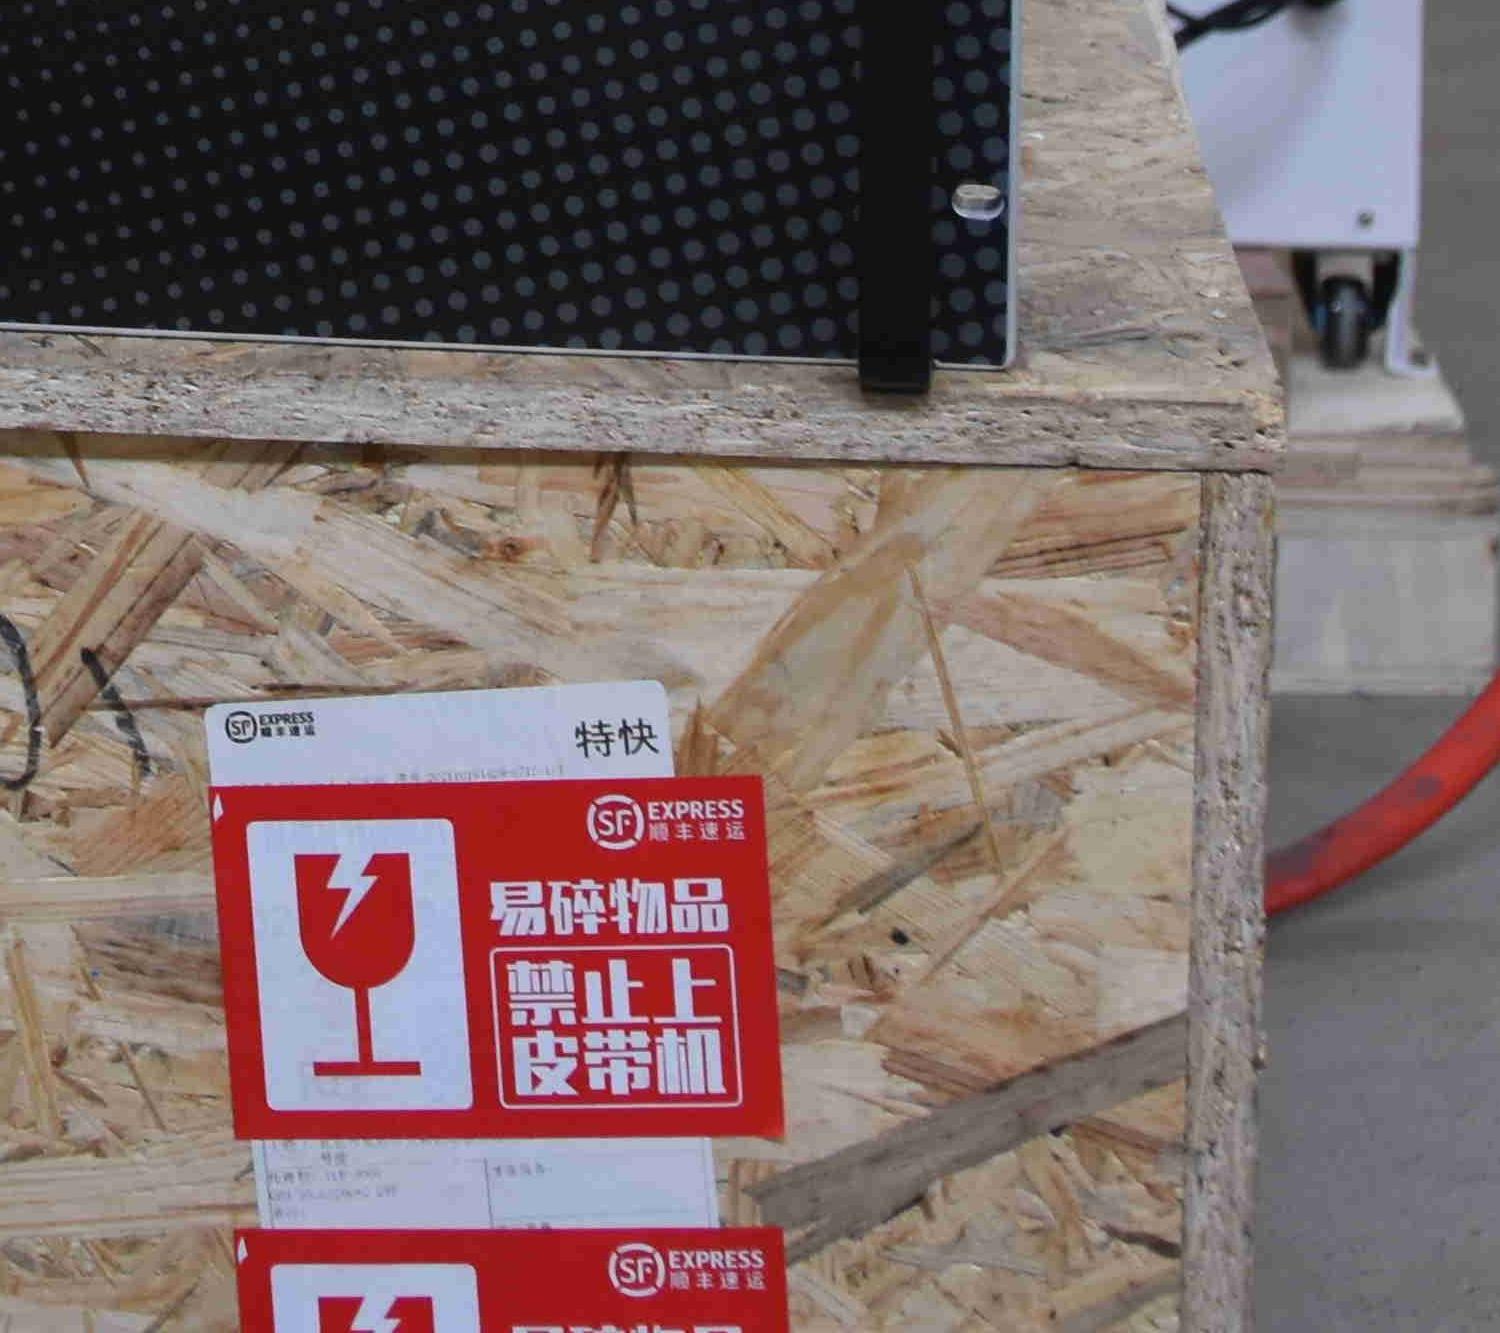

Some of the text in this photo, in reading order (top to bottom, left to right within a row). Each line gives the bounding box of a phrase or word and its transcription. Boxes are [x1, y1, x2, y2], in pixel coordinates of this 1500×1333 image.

[259, 712, 315, 724] EXPRESS
[574, 717, 659, 758] 特快
[647, 799, 745, 820] EXPRESS
[489, 877, 729, 936] 易碎物品
[506, 958, 722, 1026] 禁止上
[512, 1028, 727, 1096] 皮带机
[668, 1250, 765, 1268] EXPRESS
